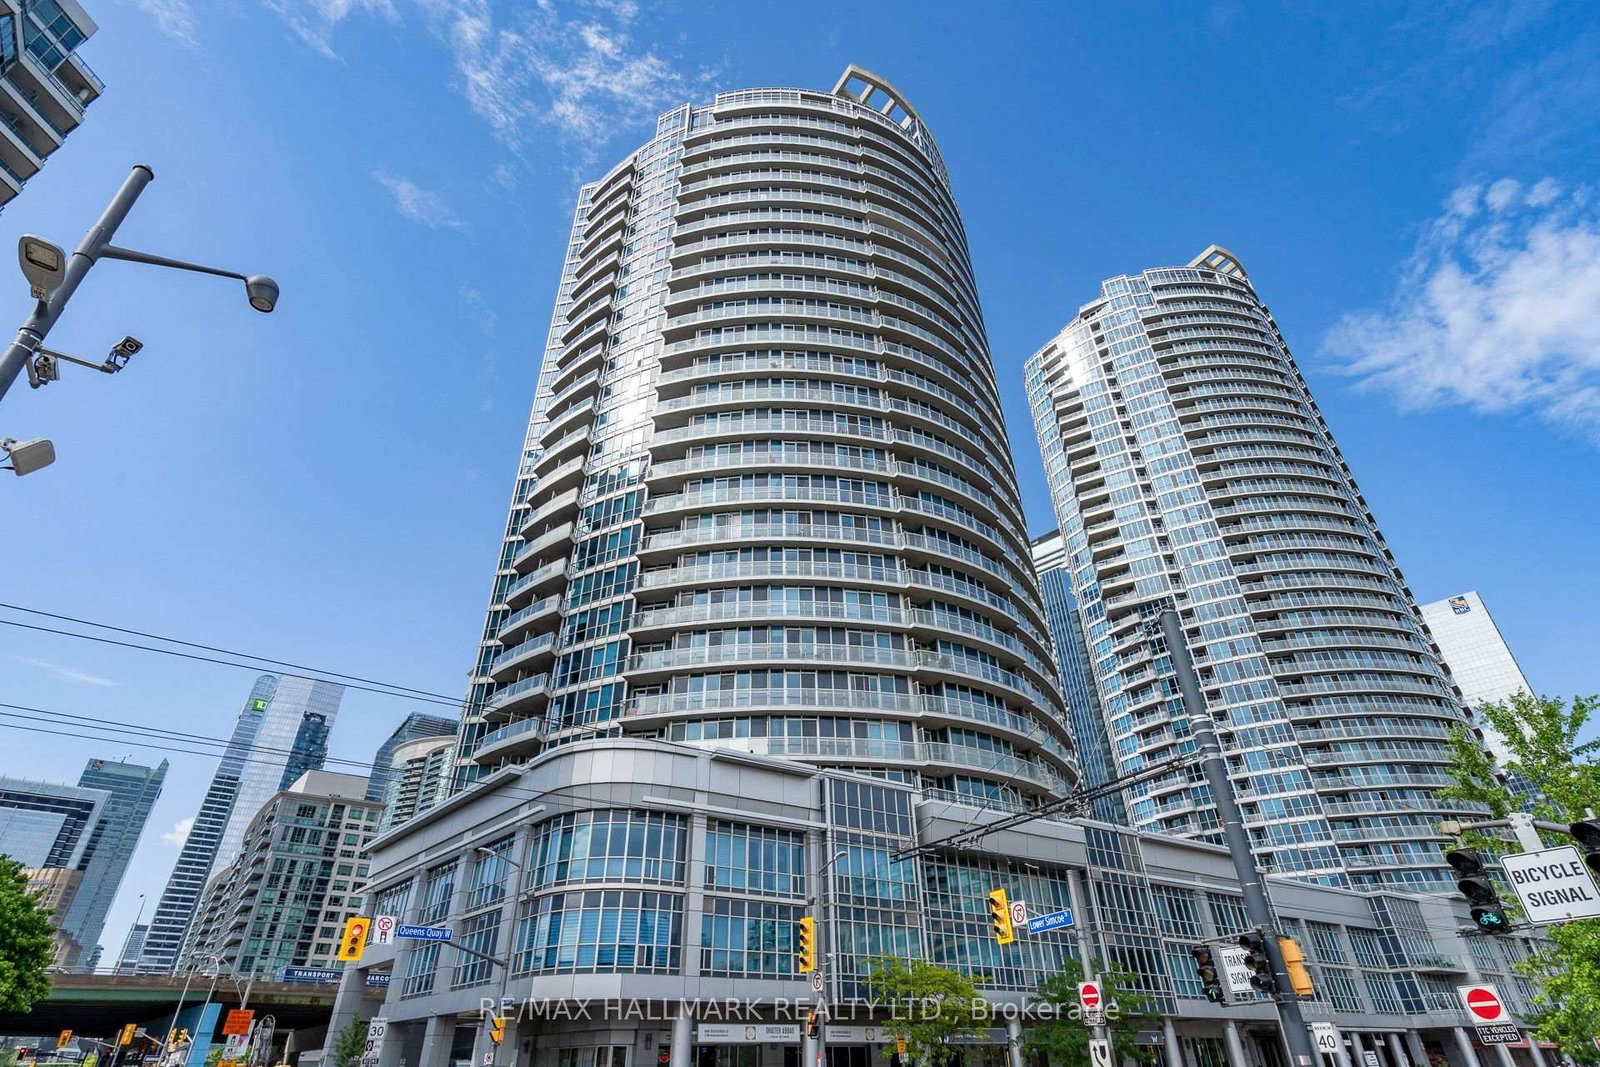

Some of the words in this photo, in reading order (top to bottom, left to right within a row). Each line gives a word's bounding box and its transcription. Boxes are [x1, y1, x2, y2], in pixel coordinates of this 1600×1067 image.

[1511, 861, 1584, 885] BICYCLE
[1527, 886, 1593, 908] SIGNAL
[1030, 919, 1045, 930] Lower
[1045, 914, 1065, 926] Simcoe
[399, 926, 425, 936] Queens
[426, 928, 443, 939] Quay
[444, 930, 451, 938] W
[1224, 952, 1250, 968] TRANS
[294, 970, 335, 979] TRANSPORT
[1230, 970, 1253, 985] SIGNA
[370, 1026, 384, 1036] 30
[1490, 1025, 1516, 1034] VEHICLES
[1319, 1035, 1336, 1048] 40
[1483, 1033, 1518, 1042] EXCEPTED
